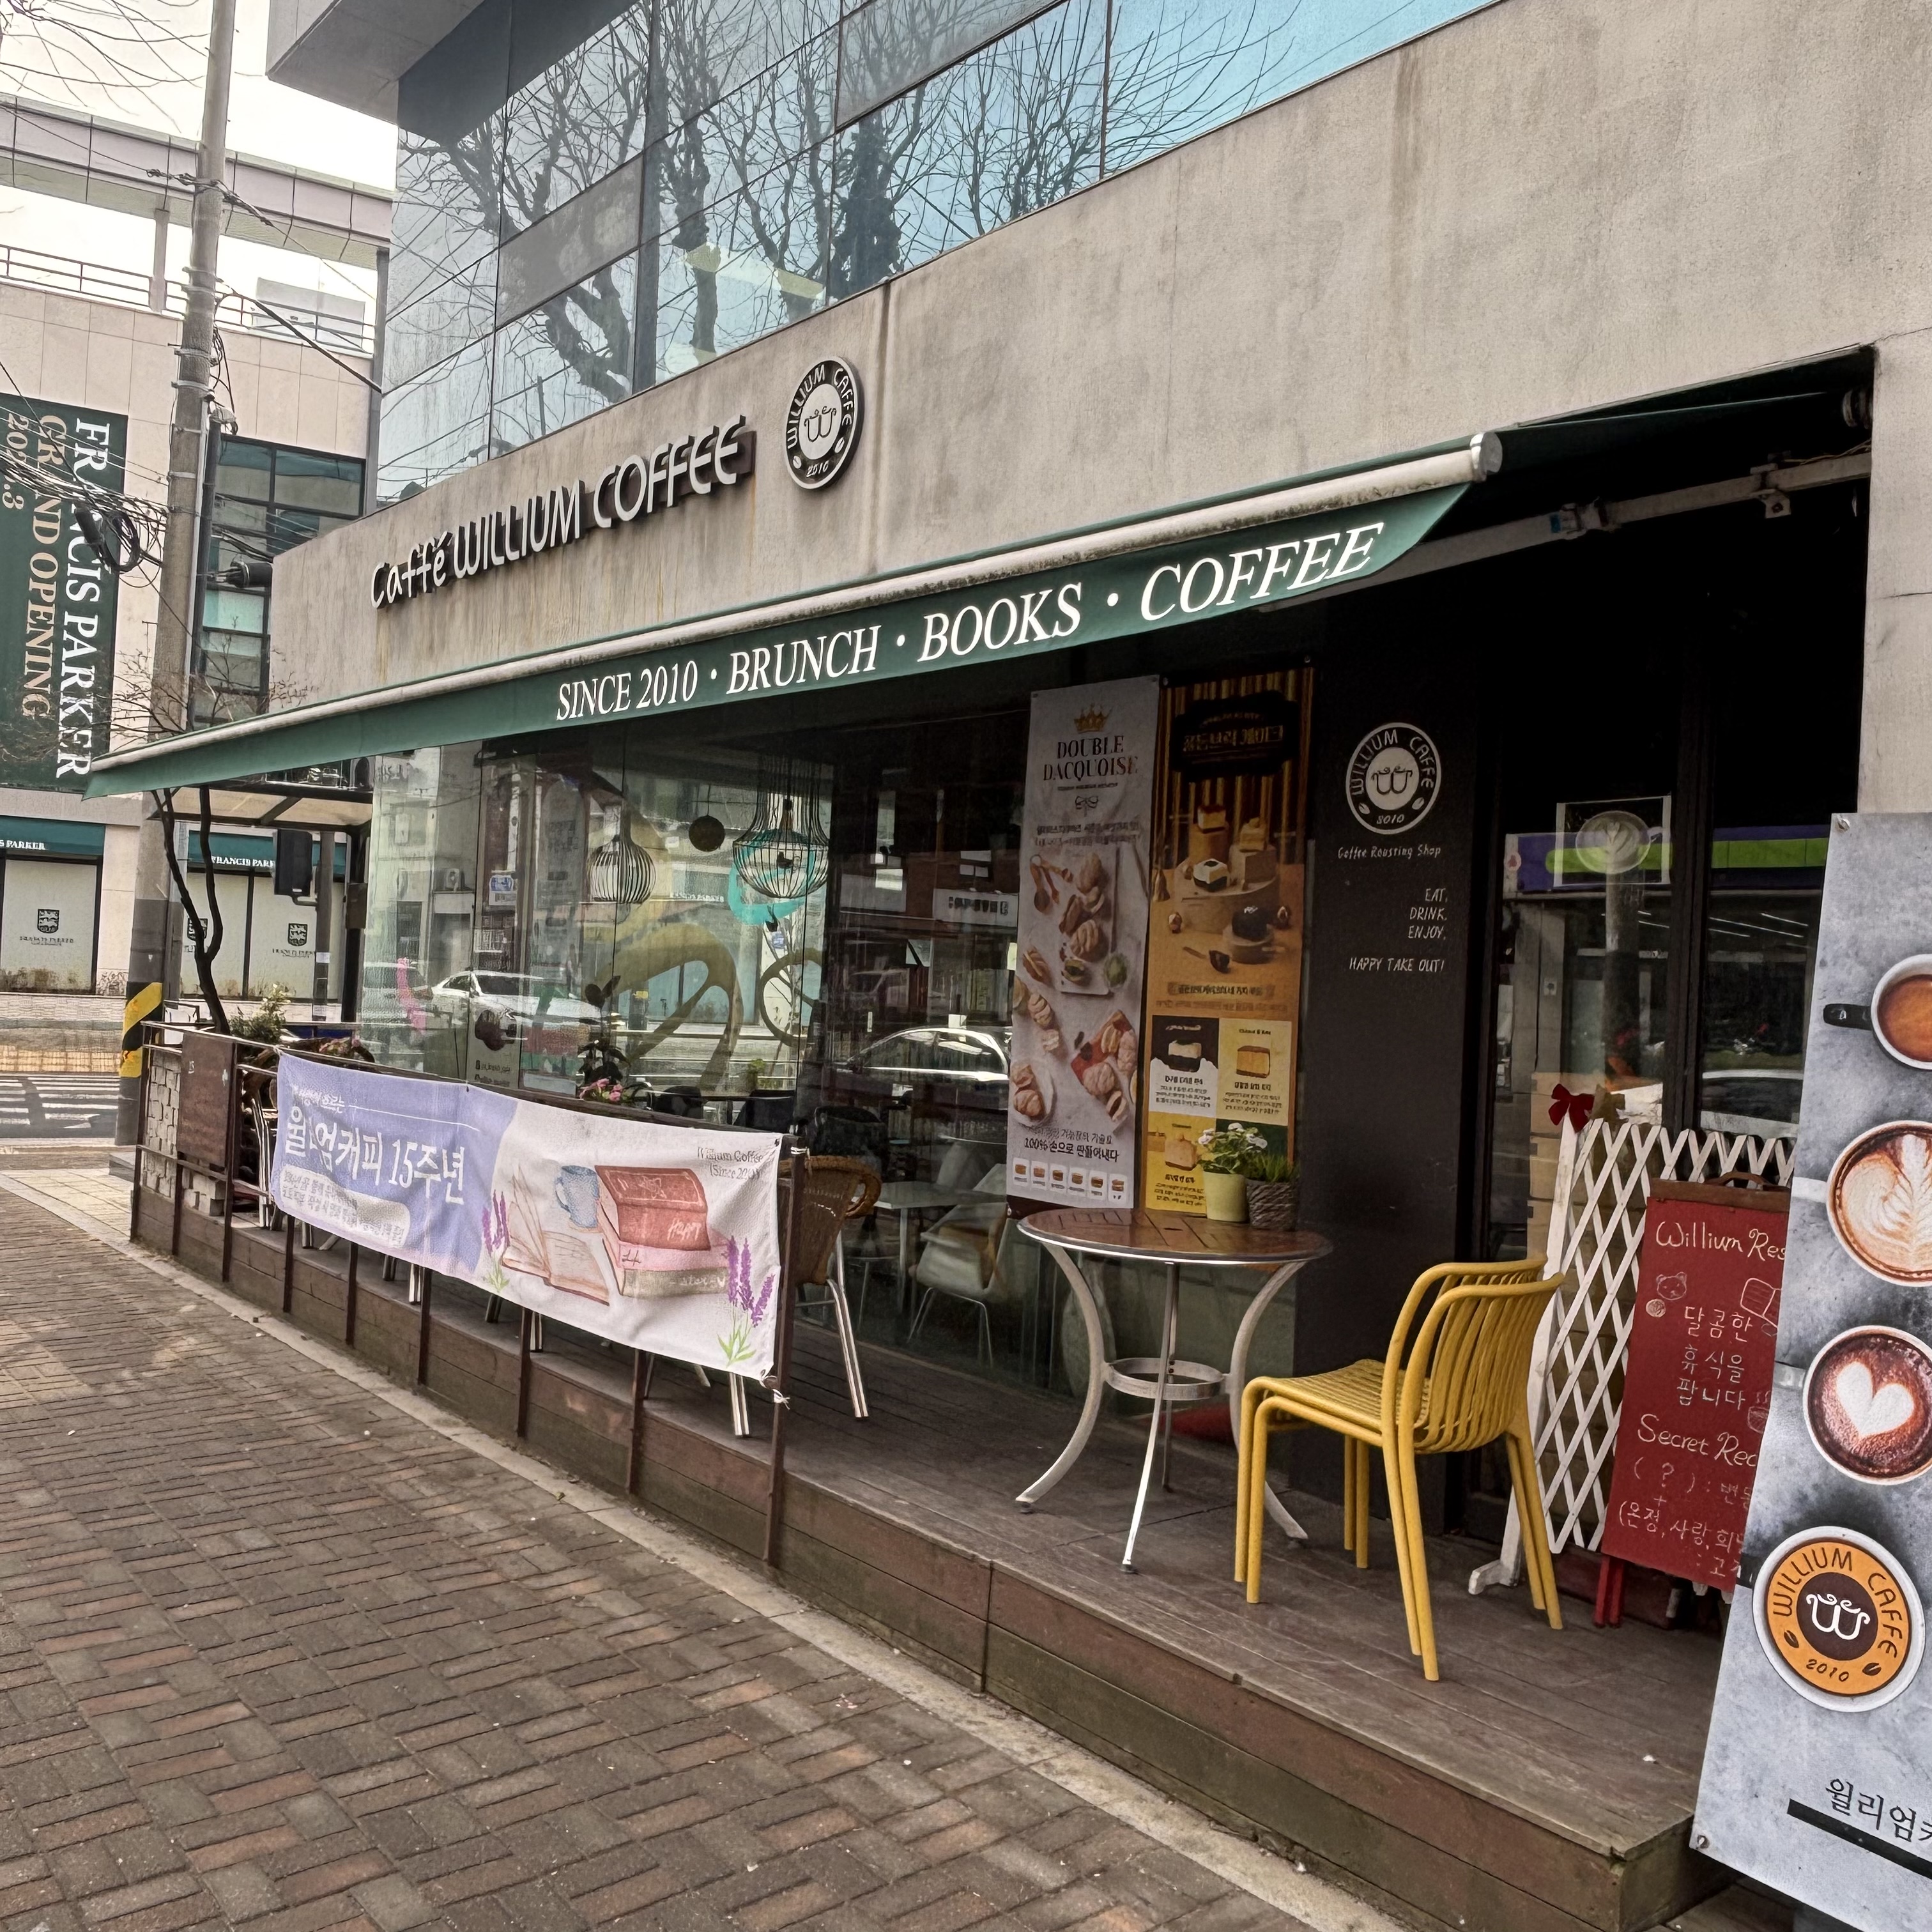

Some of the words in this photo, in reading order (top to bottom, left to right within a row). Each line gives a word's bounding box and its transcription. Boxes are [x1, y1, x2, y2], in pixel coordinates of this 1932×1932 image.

[786, 364, 825, 450] WILLIUM
[833, 367, 854, 426] CAFFE
[2, 412, 29, 510] 202.3
[32, 414, 67, 546] GRND
[65, 417, 111, 603] FRCIS
[453, 479, 583, 579] WILLIUM
[593, 415, 746, 529] COFFEE
[22, 552, 59, 719] OPENING
[556, 671, 632, 721] SINCE
[636, 659, 698, 709] 2010
[726, 625, 882, 694] BRUNCH
[916, 581, 1082, 663] BOOKS
[1140, 521, 1385, 622] COFFEE
[56, 610, 98, 779] PARKER
[1043, 756, 1138, 782] DACQUOISE
[1057, 735, 1124, 759] DOUBLE
[1351, 728, 1399, 796] WILLIUM
[1409, 736, 1436, 788] CAFFE
[1337, 846, 1367, 860] Coffee
[1416, 843, 1441, 859] Shop
[1349, 956, 1384, 971] HAPPY
[1387, 958, 1413, 972] TAKE
[388, 1138, 465, 1206] 15주년
[1655, 1221, 1744, 1254] Willium
[1683, 1305, 1753, 1343] 달콤한
[1676, 1377, 1746, 1411] 팝니다
[1681, 1344, 1745, 1384] 휴식을
[1637, 1413, 1710, 1456] Secret
[1772, 1545, 1853, 1618] WILLIUM
[1867, 1570, 1904, 1659] CAFFE
[1805, 1658, 1850, 1683] 2010
